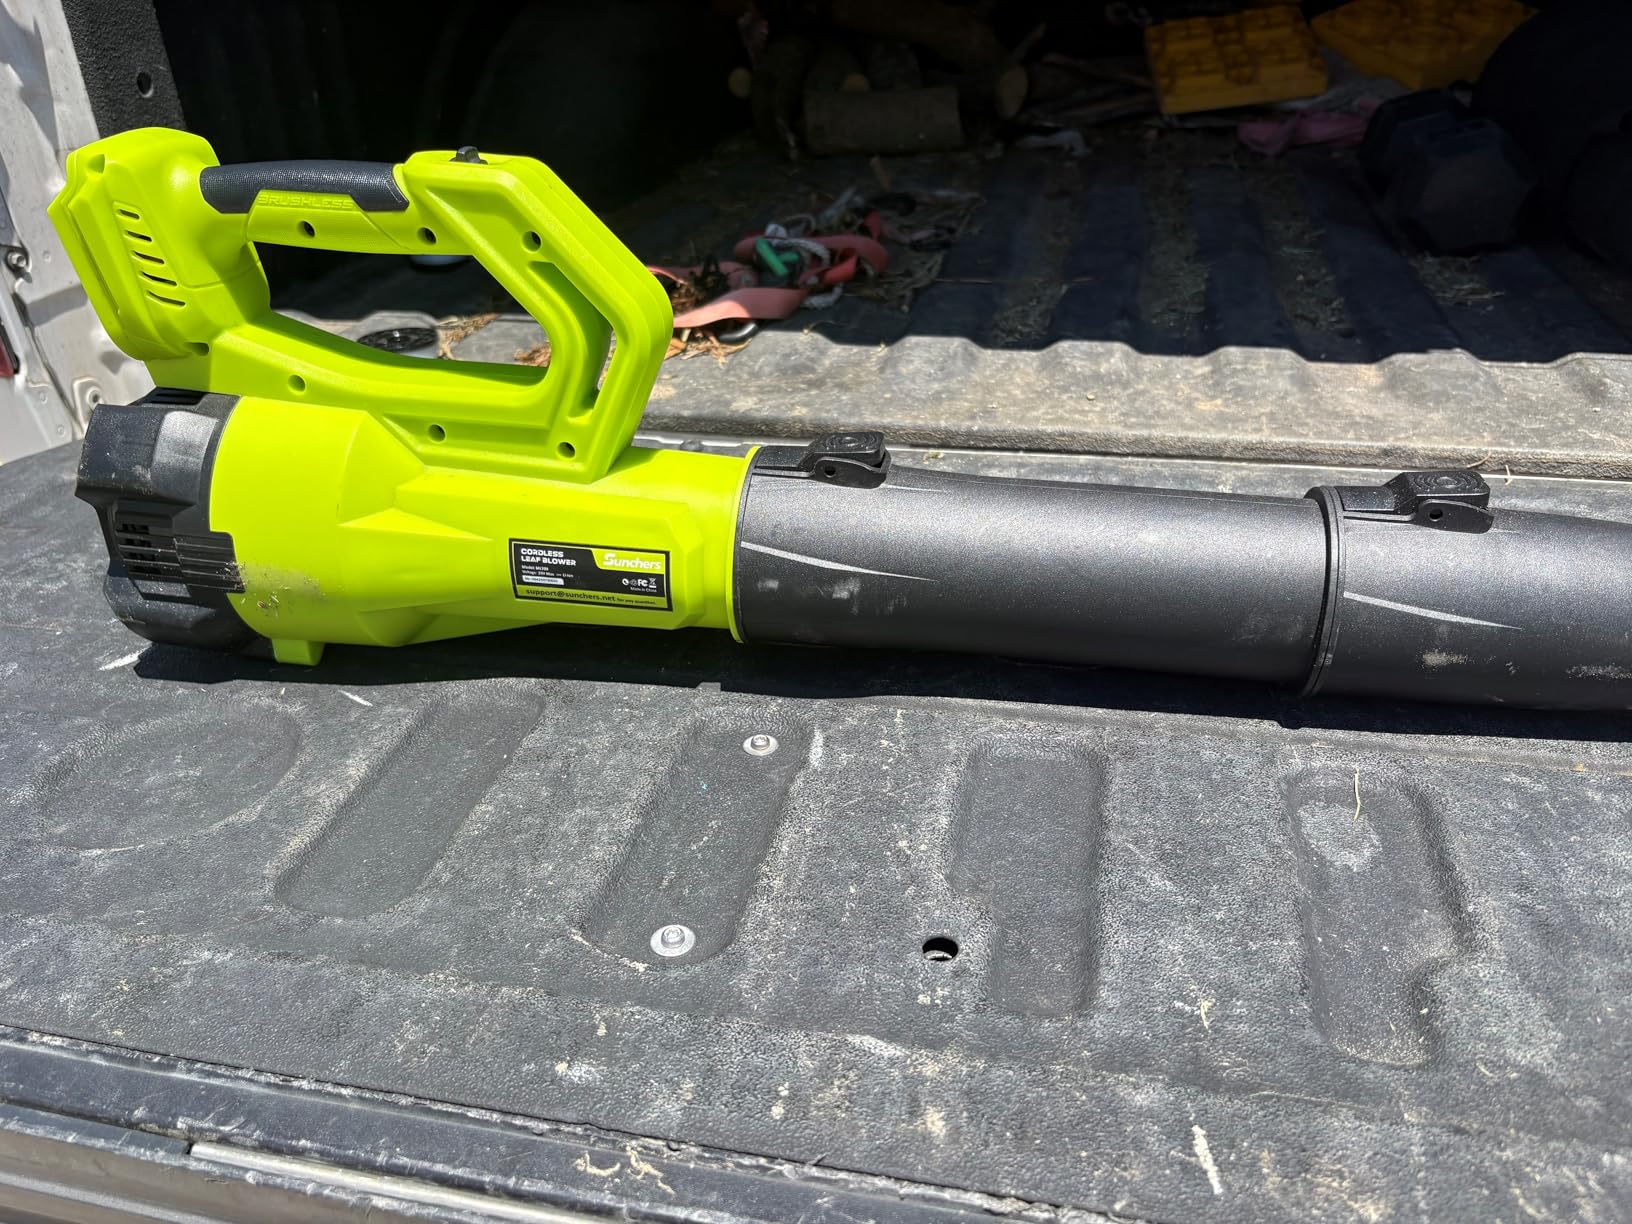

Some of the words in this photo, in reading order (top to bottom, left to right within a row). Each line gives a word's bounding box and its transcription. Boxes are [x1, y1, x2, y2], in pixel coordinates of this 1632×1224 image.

[258, 194, 354, 209] BRUSHLESS
[520, 548, 564, 557] CORDLESS
[542, 557, 577, 566] BLOWER
[603, 553, 662, 570] Sunchers
[525, 589, 615, 602] support@sunchers.net
